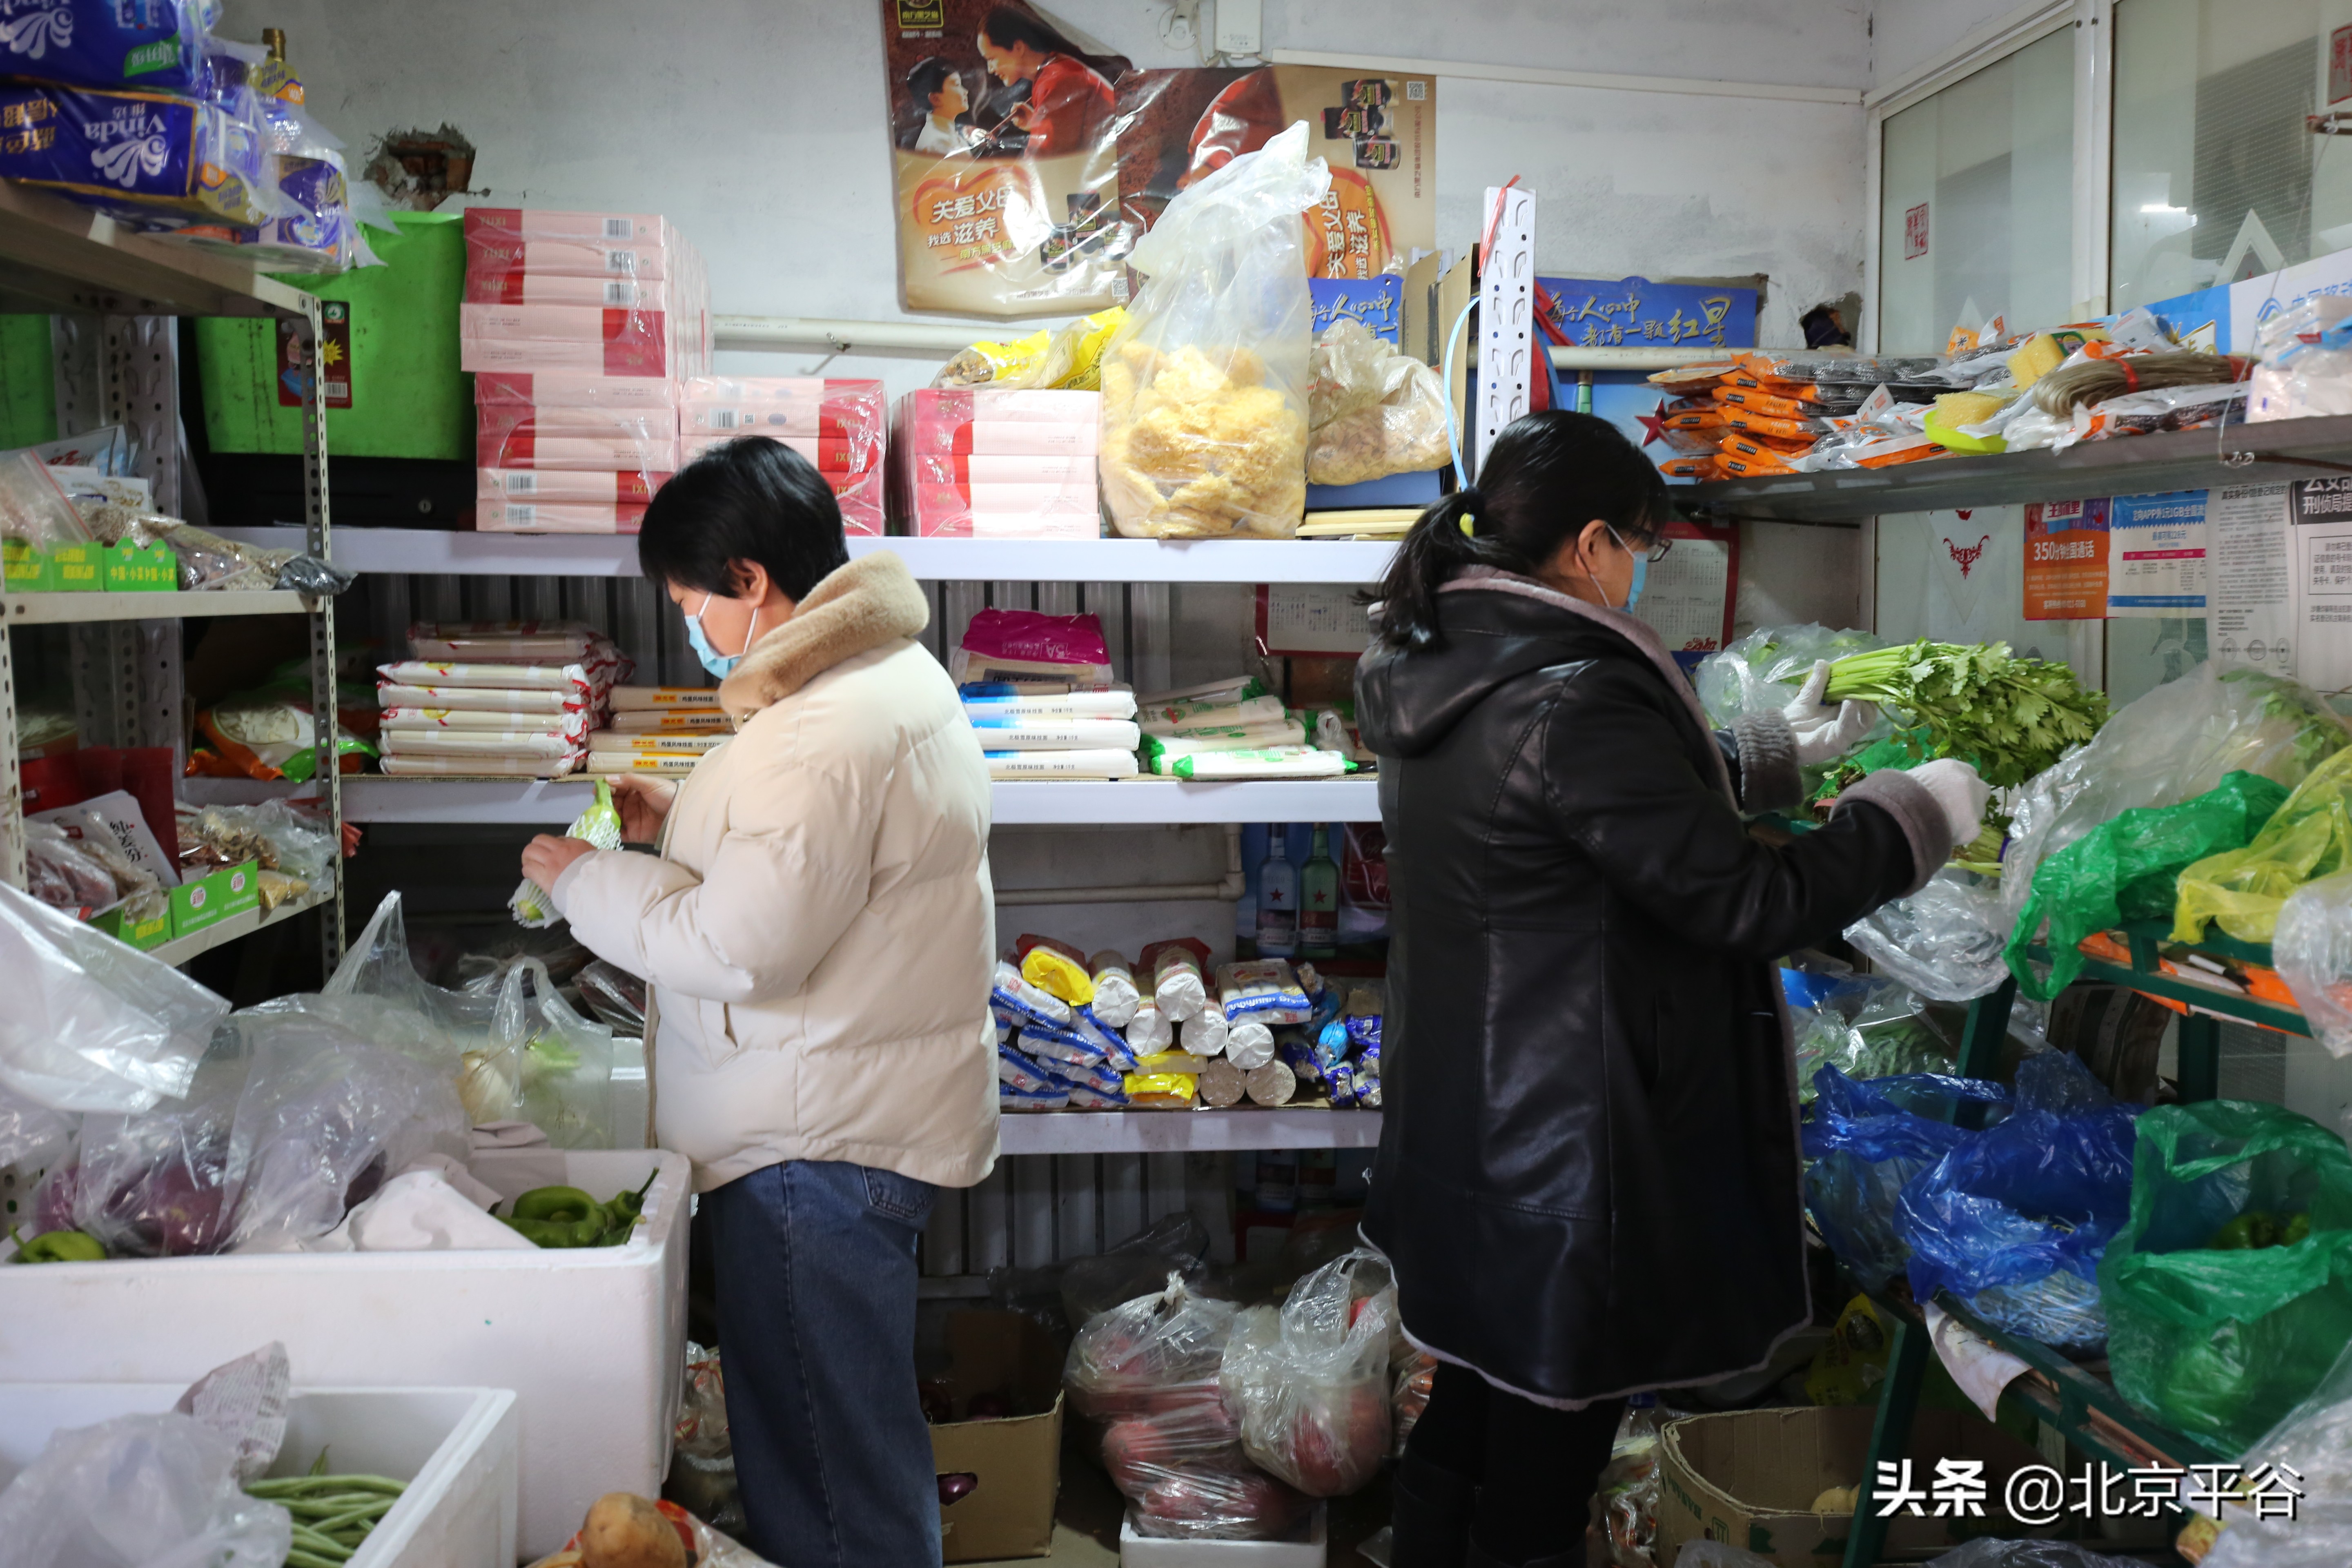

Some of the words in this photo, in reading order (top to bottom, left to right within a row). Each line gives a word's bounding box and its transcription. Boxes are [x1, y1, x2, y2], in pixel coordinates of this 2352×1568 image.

[83, 114, 167, 143] Vinda
[929, 185, 1013, 223] 关爱父母
[928, 217, 1000, 248] 我选滋养
[960, 239, 1015, 260] 南方黑芝麻
